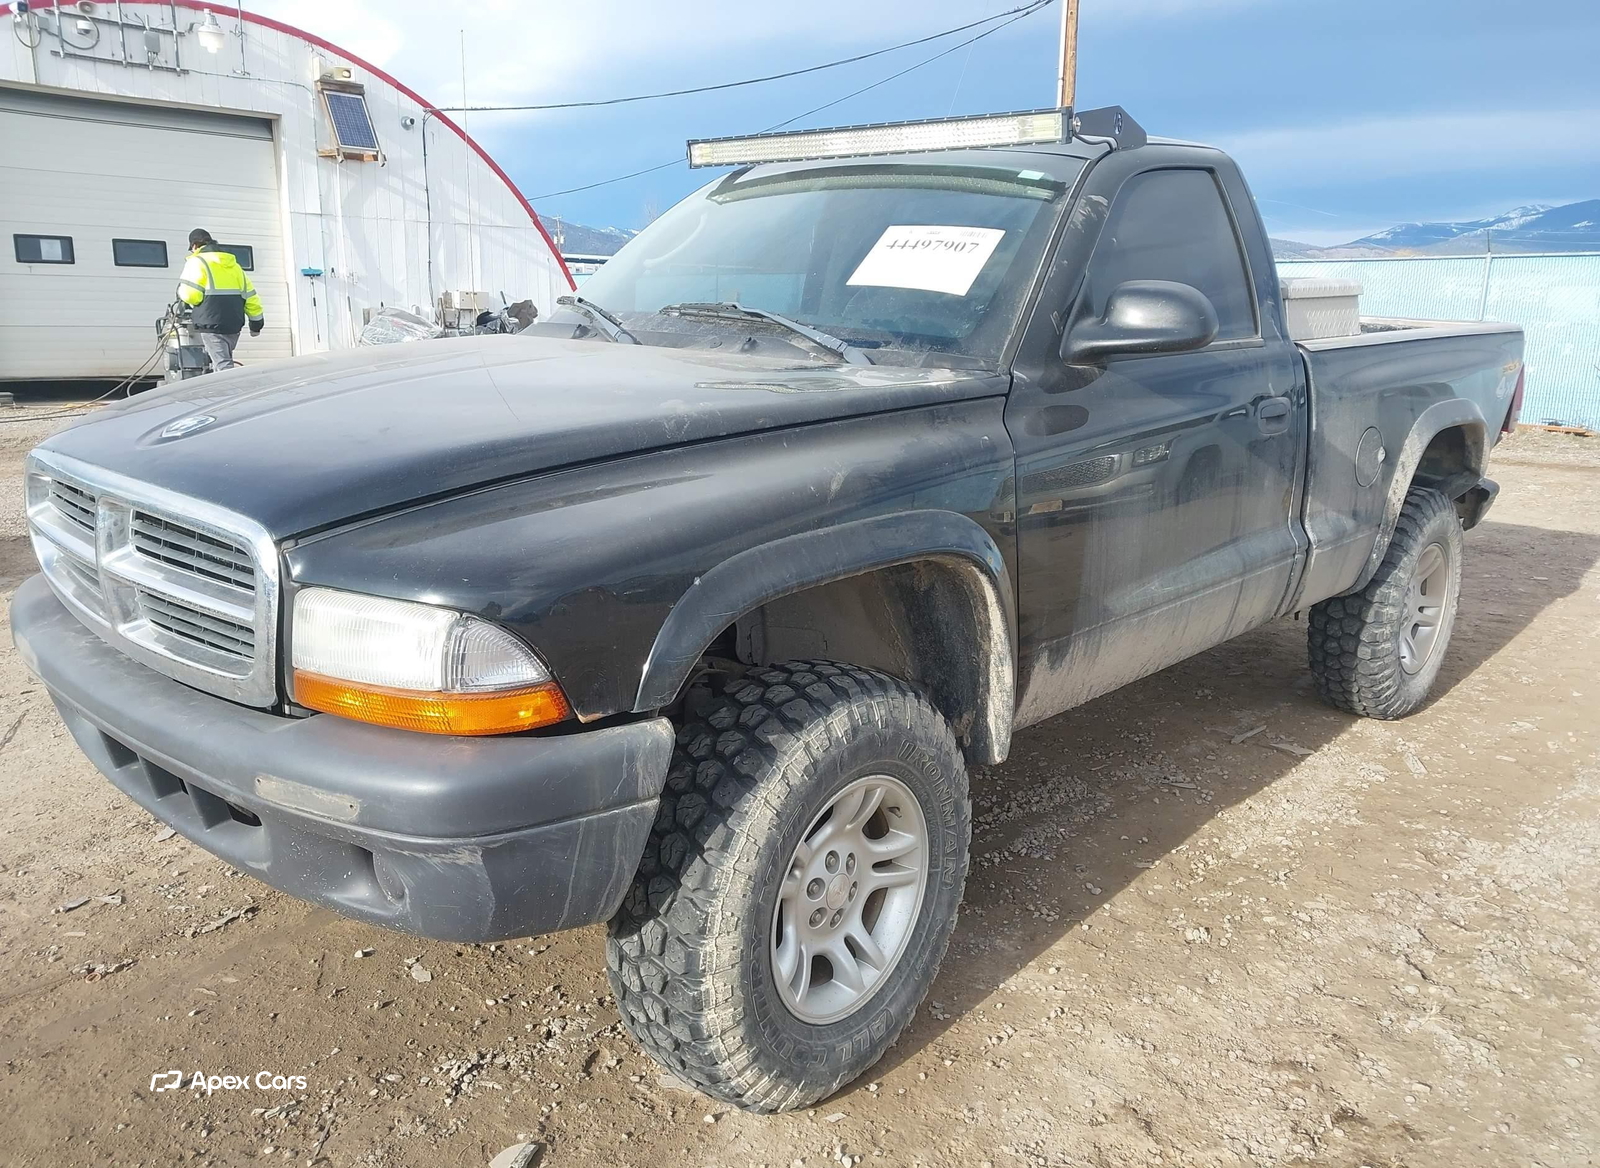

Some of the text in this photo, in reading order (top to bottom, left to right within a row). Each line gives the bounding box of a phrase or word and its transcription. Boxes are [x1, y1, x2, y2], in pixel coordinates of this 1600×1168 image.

[886, 239, 979, 253] 44497907
[898, 738, 958, 889] IRONMAN
[835, 1008, 890, 1062] ALL
